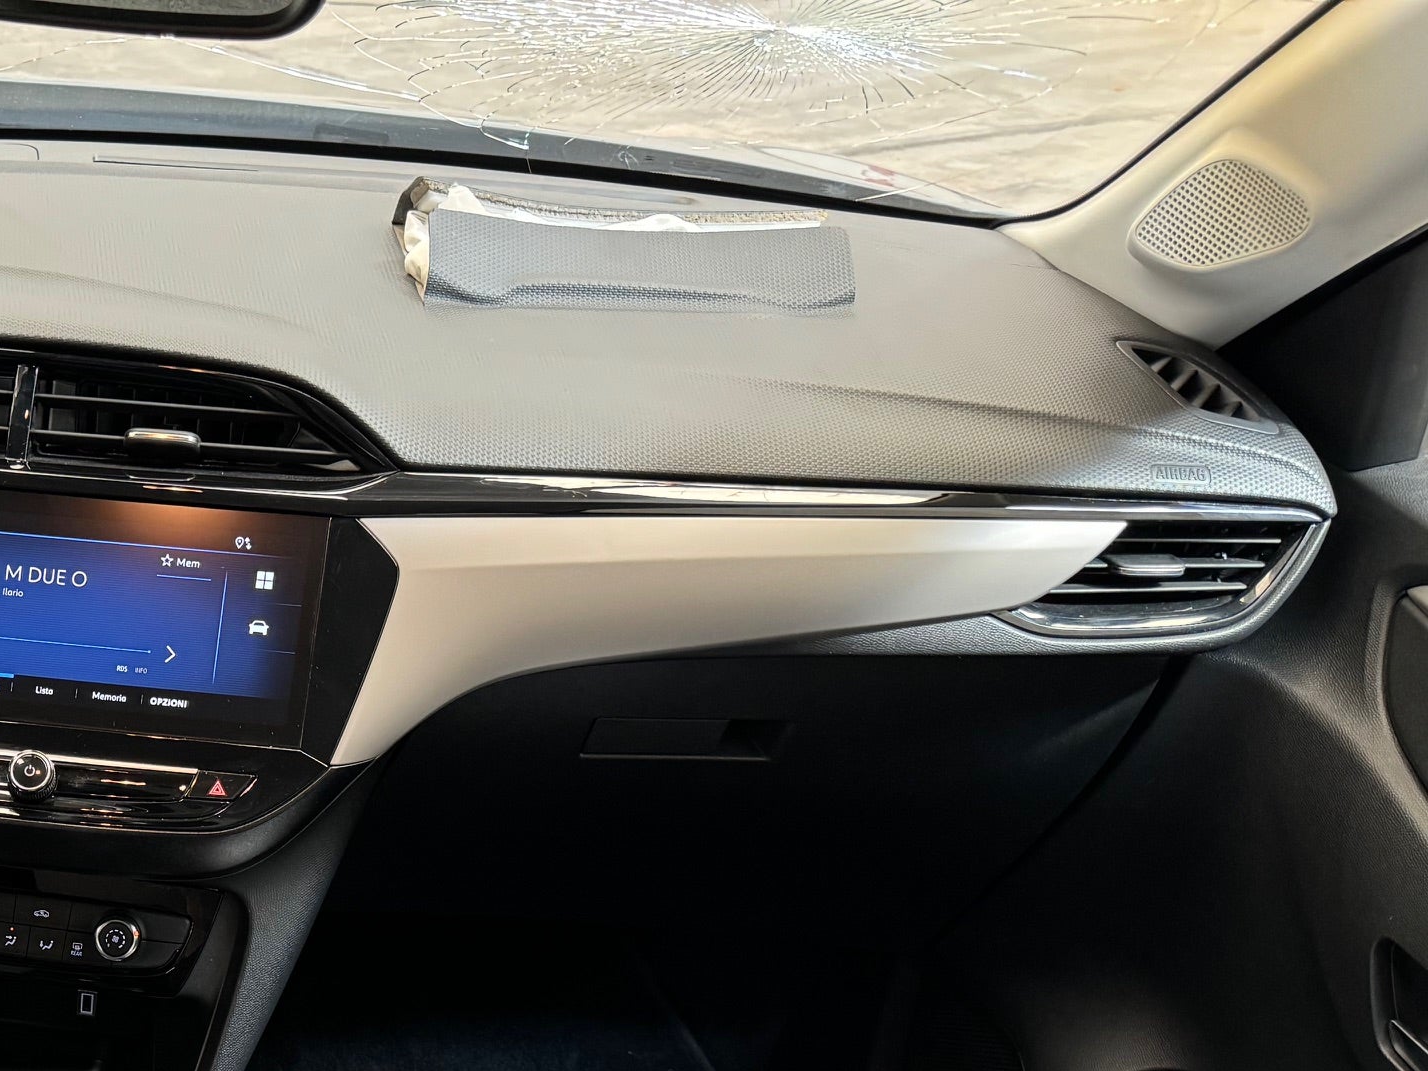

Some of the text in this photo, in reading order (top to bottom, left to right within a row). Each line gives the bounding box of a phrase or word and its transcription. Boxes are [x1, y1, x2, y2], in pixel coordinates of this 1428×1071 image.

[1155, 466, 1207, 481] AIRBAG
[176, 557, 201, 569] Mem
[4, 565, 88, 587] M DUE O
[3, 588, 24, 598] Ilario
[116, 665, 128, 673] RDS
[35, 685, 54, 696] Lista
[92, 691, 127, 703] Memoria
[150, 697, 188, 709] OPZIONI
